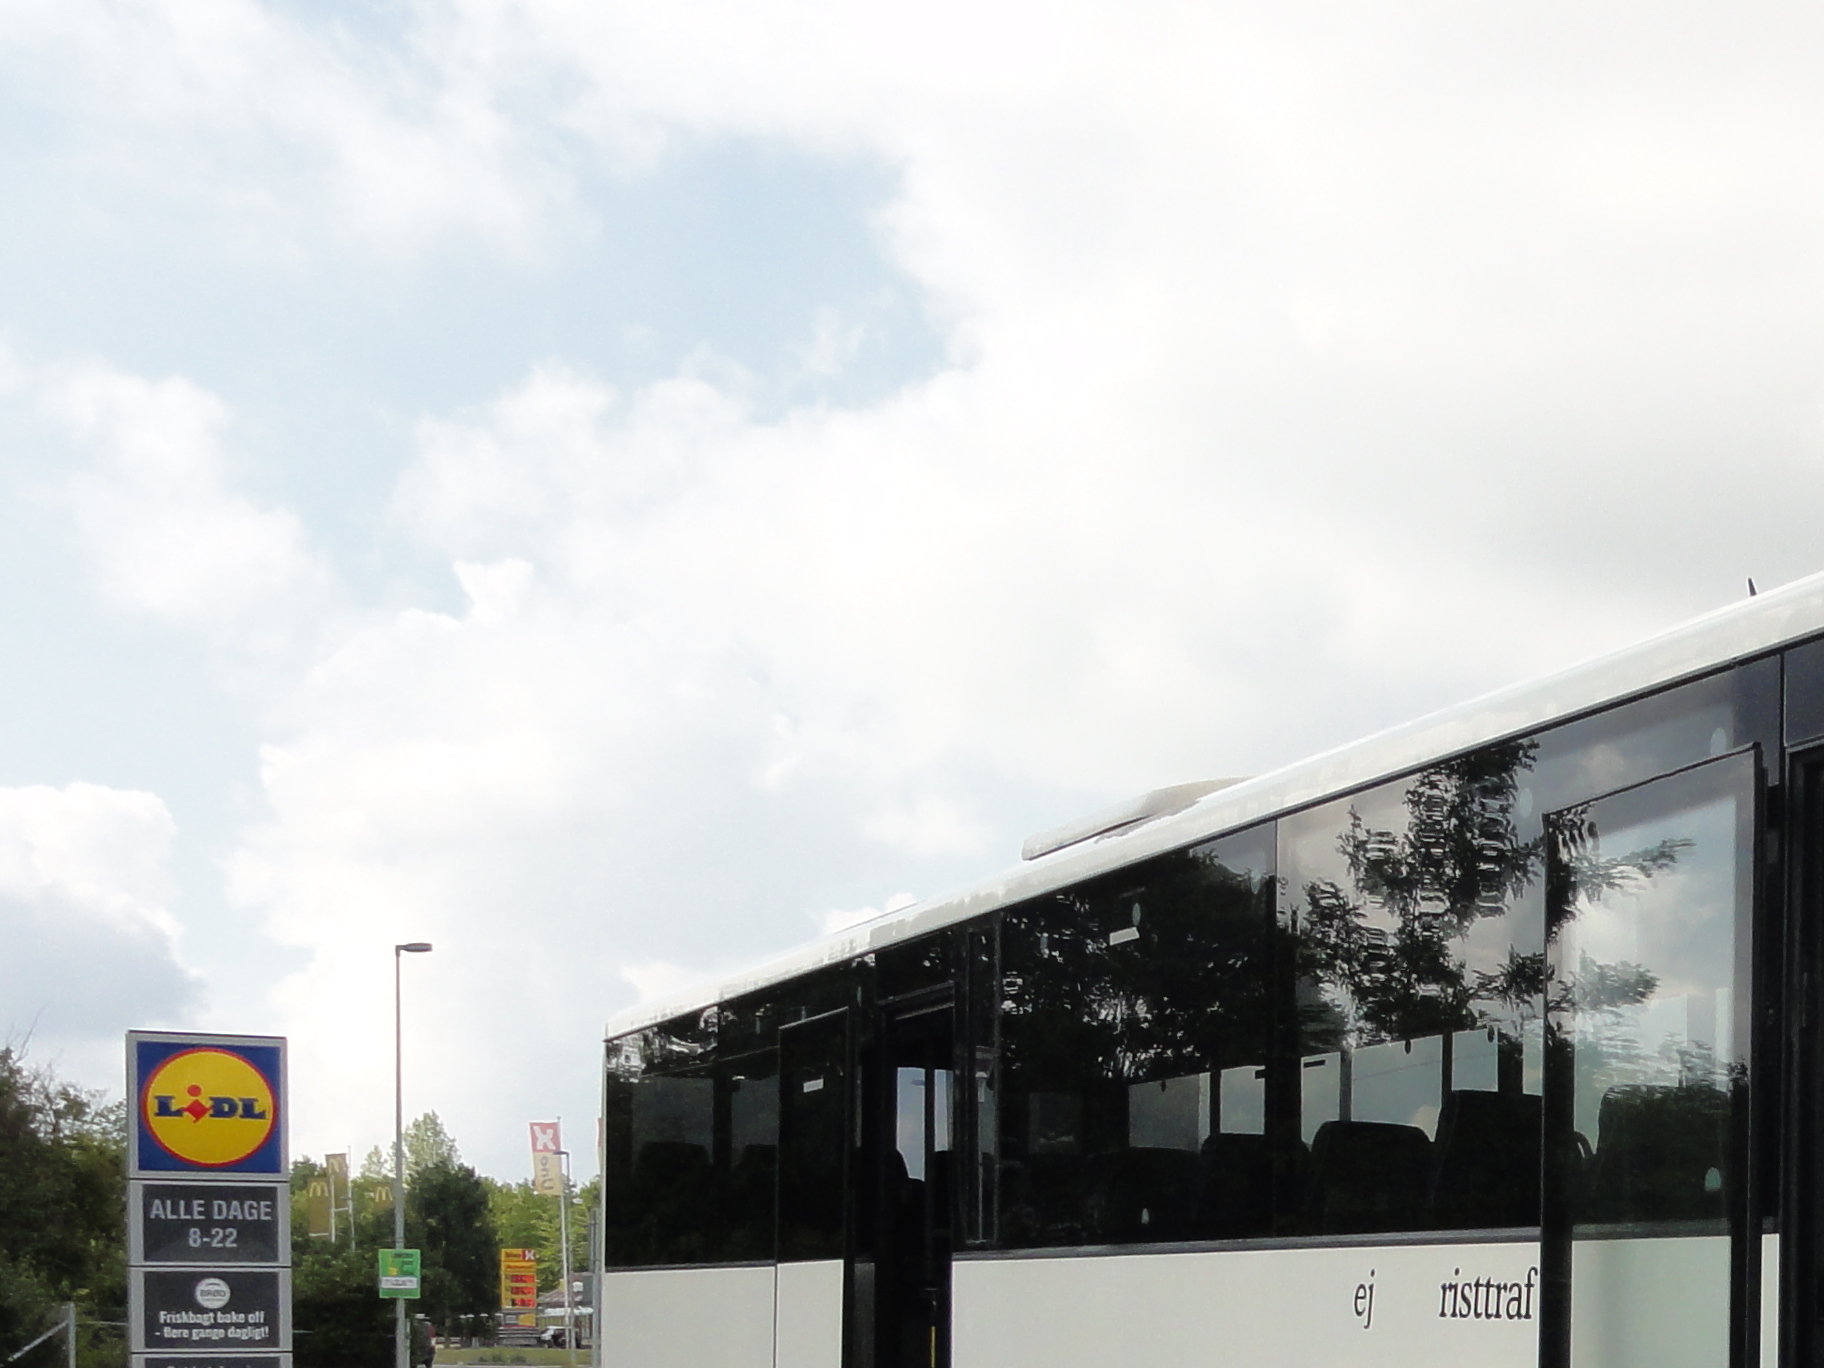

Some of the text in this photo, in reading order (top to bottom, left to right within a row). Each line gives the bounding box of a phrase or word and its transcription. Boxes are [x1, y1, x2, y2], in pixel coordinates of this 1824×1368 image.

[150, 1199, 272, 1221] ALLE DAGE
[188, 1228, 238, 1249] 8-22
[1354, 1268, 1376, 1330] ej
[159, 1310, 265, 1326] Friskbagt bake off
[192, 1327, 226, 1340] gange
[228, 1326, 270, 1340] dagligt!
